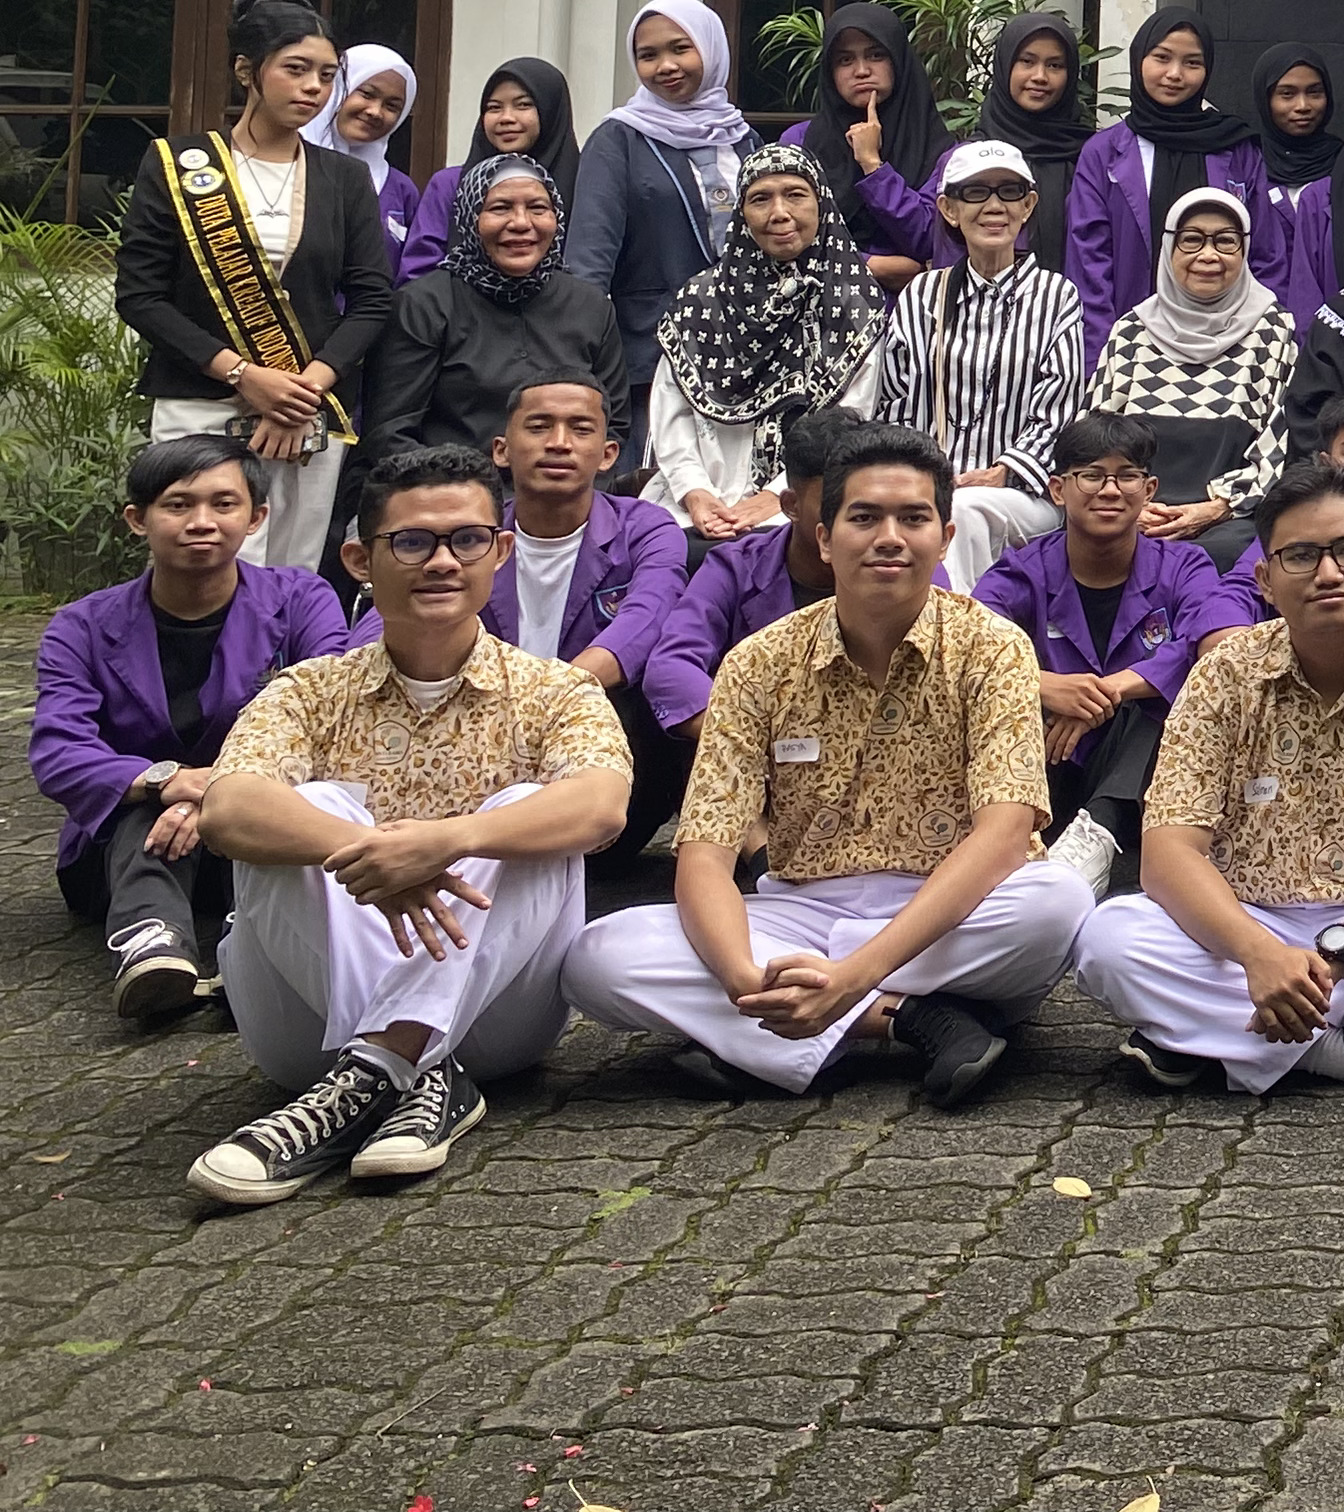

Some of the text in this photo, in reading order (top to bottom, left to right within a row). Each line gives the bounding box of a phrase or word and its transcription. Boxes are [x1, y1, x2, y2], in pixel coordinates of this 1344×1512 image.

[194, 193, 233, 232] DUTA
[205, 225, 254, 283] PELAJAR
[227, 275, 277, 329] KREATIF
